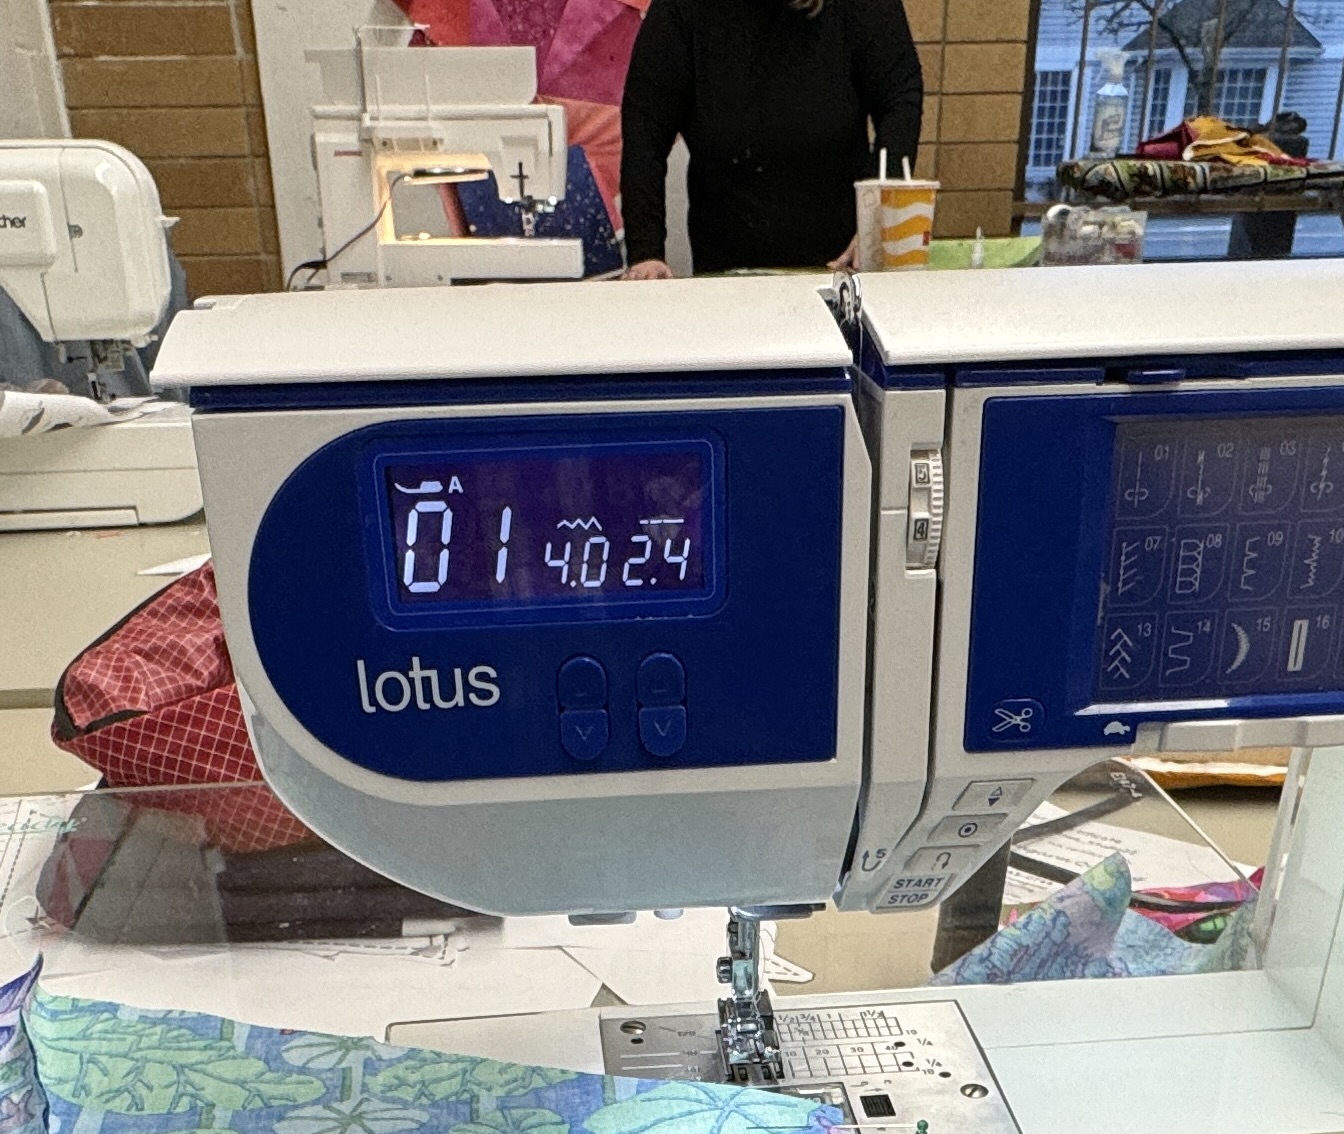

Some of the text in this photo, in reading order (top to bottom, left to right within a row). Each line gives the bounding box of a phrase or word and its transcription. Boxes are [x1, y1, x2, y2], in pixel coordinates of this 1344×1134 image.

[1154, 445, 1169, 461] 01
[1217, 443, 1234, 458] 02
[448, 475, 464, 494] A
[1144, 536, 1162, 552] 07
[1206, 533, 1223, 548] 08
[1267, 531, 1284, 547] 09
[1329, 527, 1344, 544] 10
[1137, 622, 1153, 638] 13
[1197, 618, 1212, 635] 14
[1256, 617, 1272, 632] 15
[1316, 614, 1331, 630] 16
[356, 656, 501, 713] lotus
[893, 876, 946, 890] START
[887, 892, 930, 905] STOP
